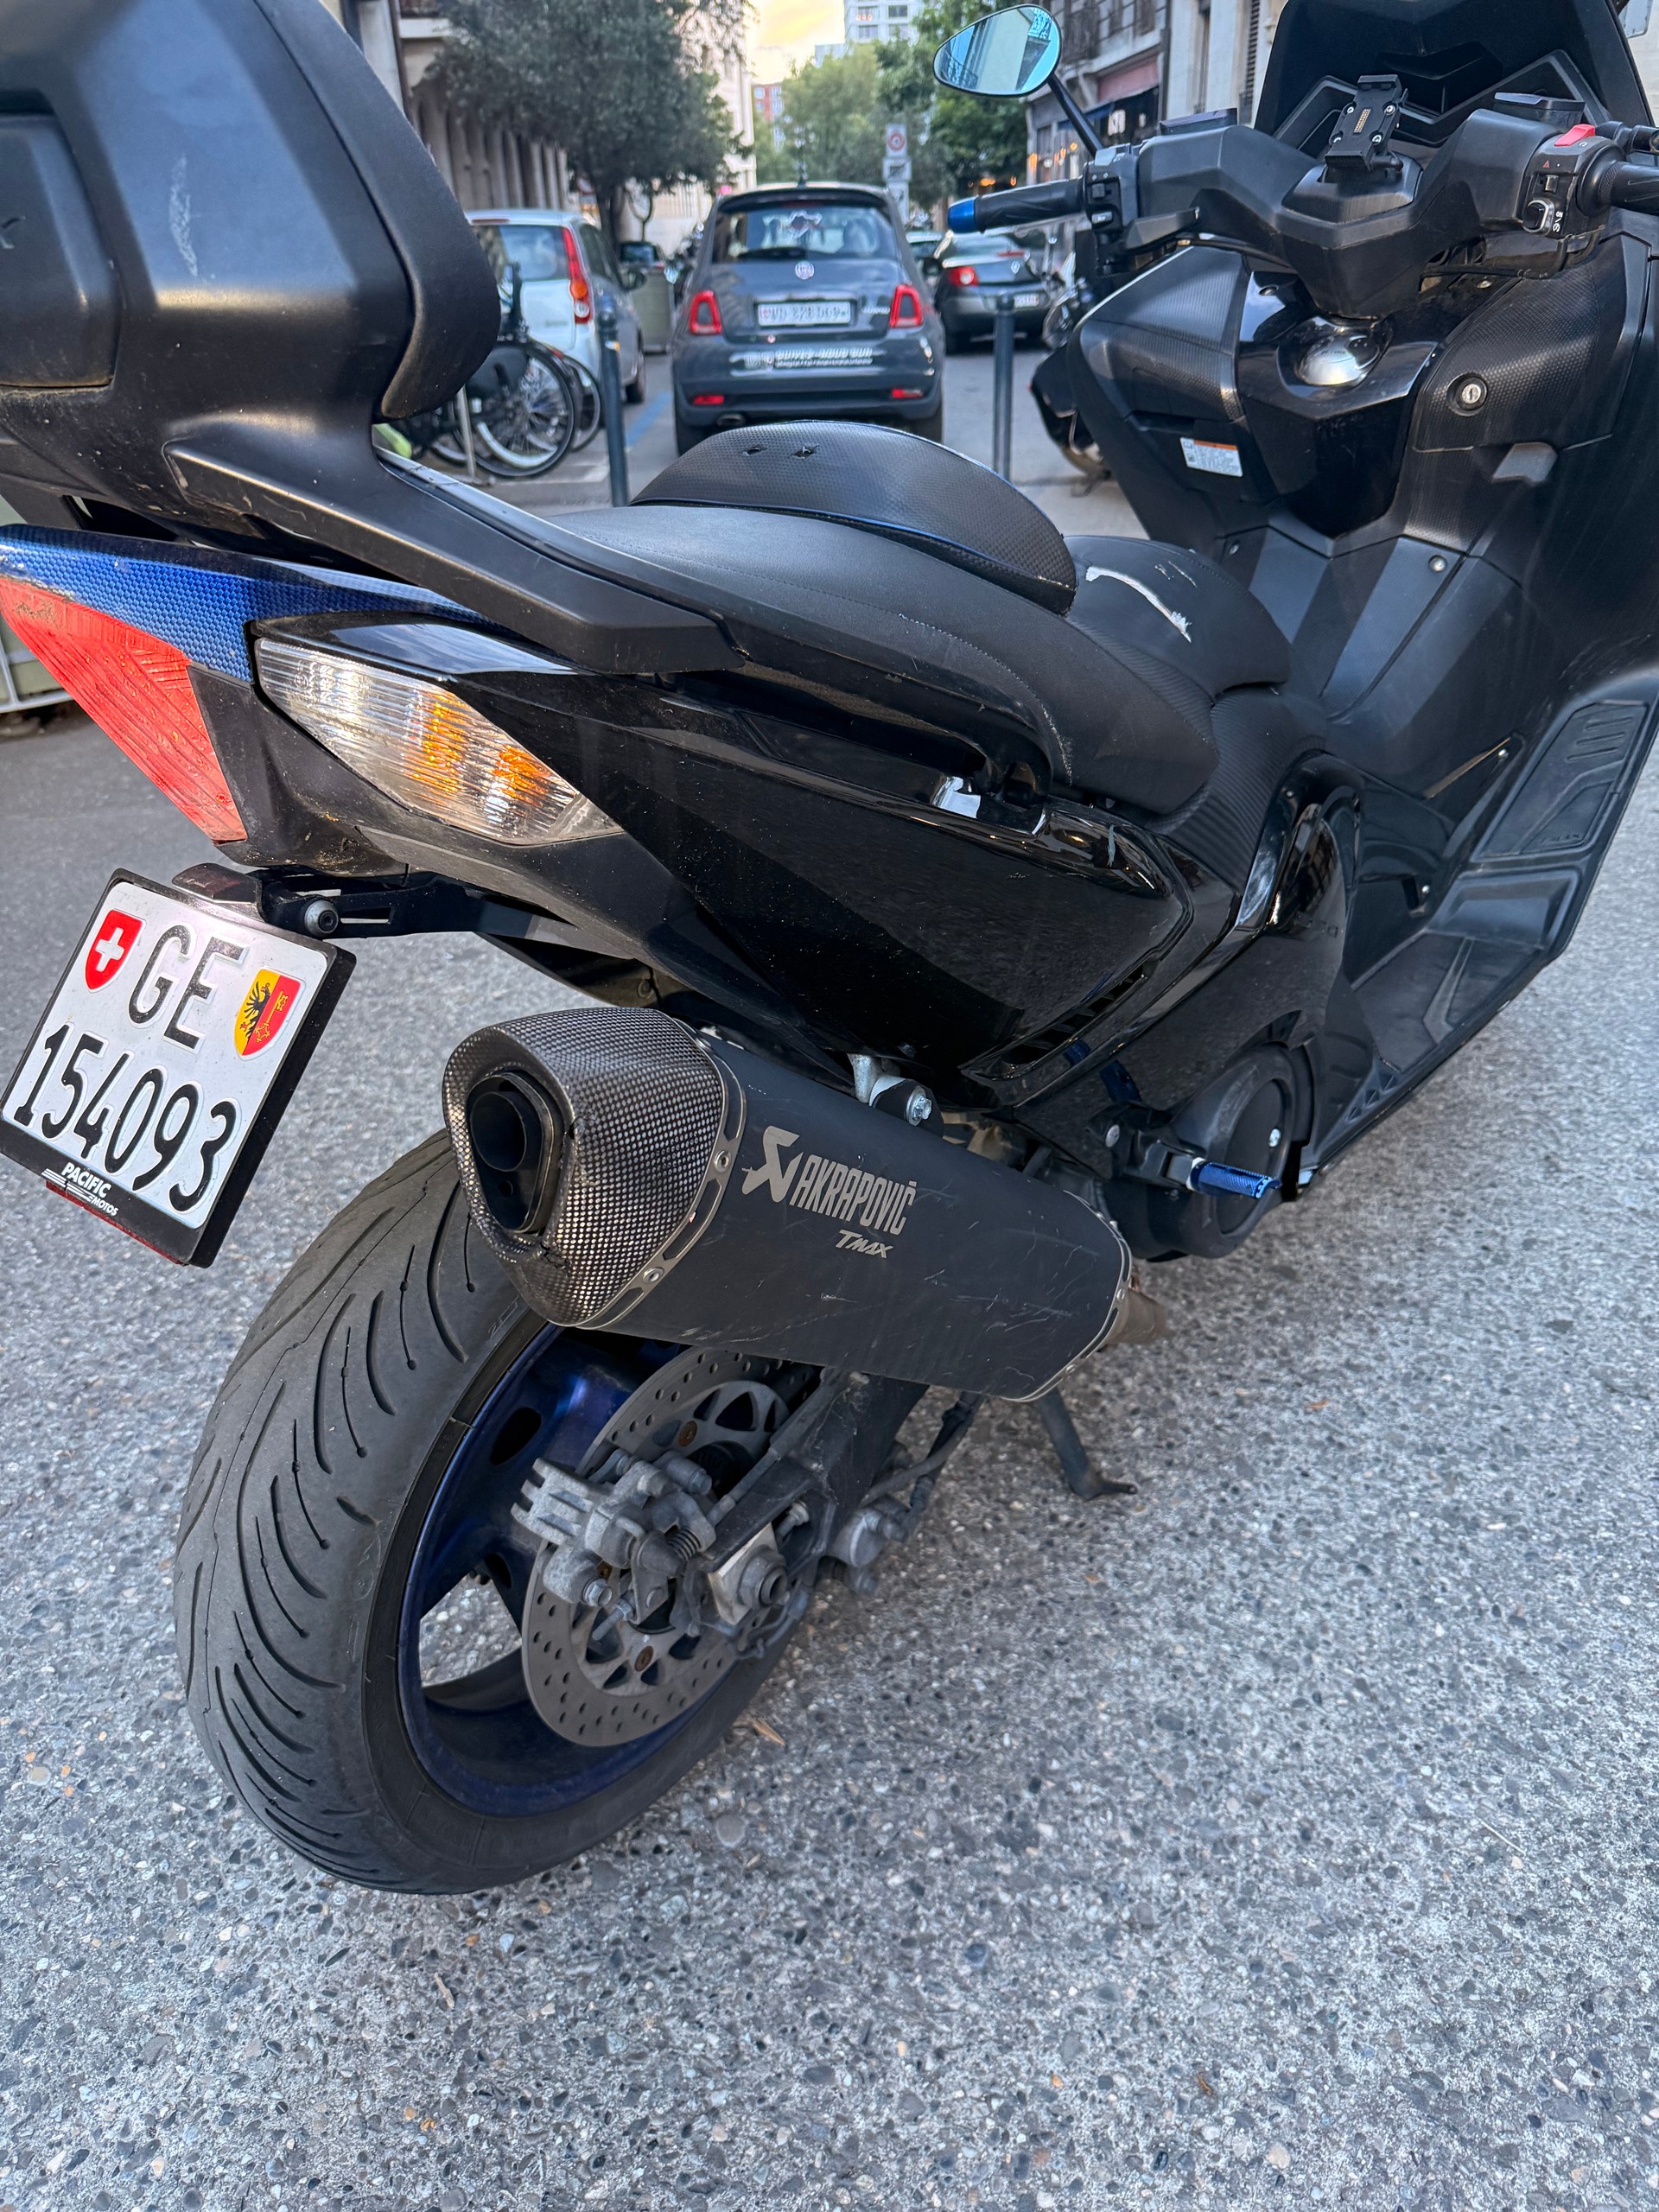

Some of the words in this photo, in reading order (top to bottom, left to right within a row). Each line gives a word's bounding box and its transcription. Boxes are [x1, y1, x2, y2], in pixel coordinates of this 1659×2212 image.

[129, 925, 246, 1050] GE
[14, 1024, 237, 1212] 154093
[60, 1161, 112, 1198] PACIFIC
[91, 1196, 119, 1217] MOTOS
